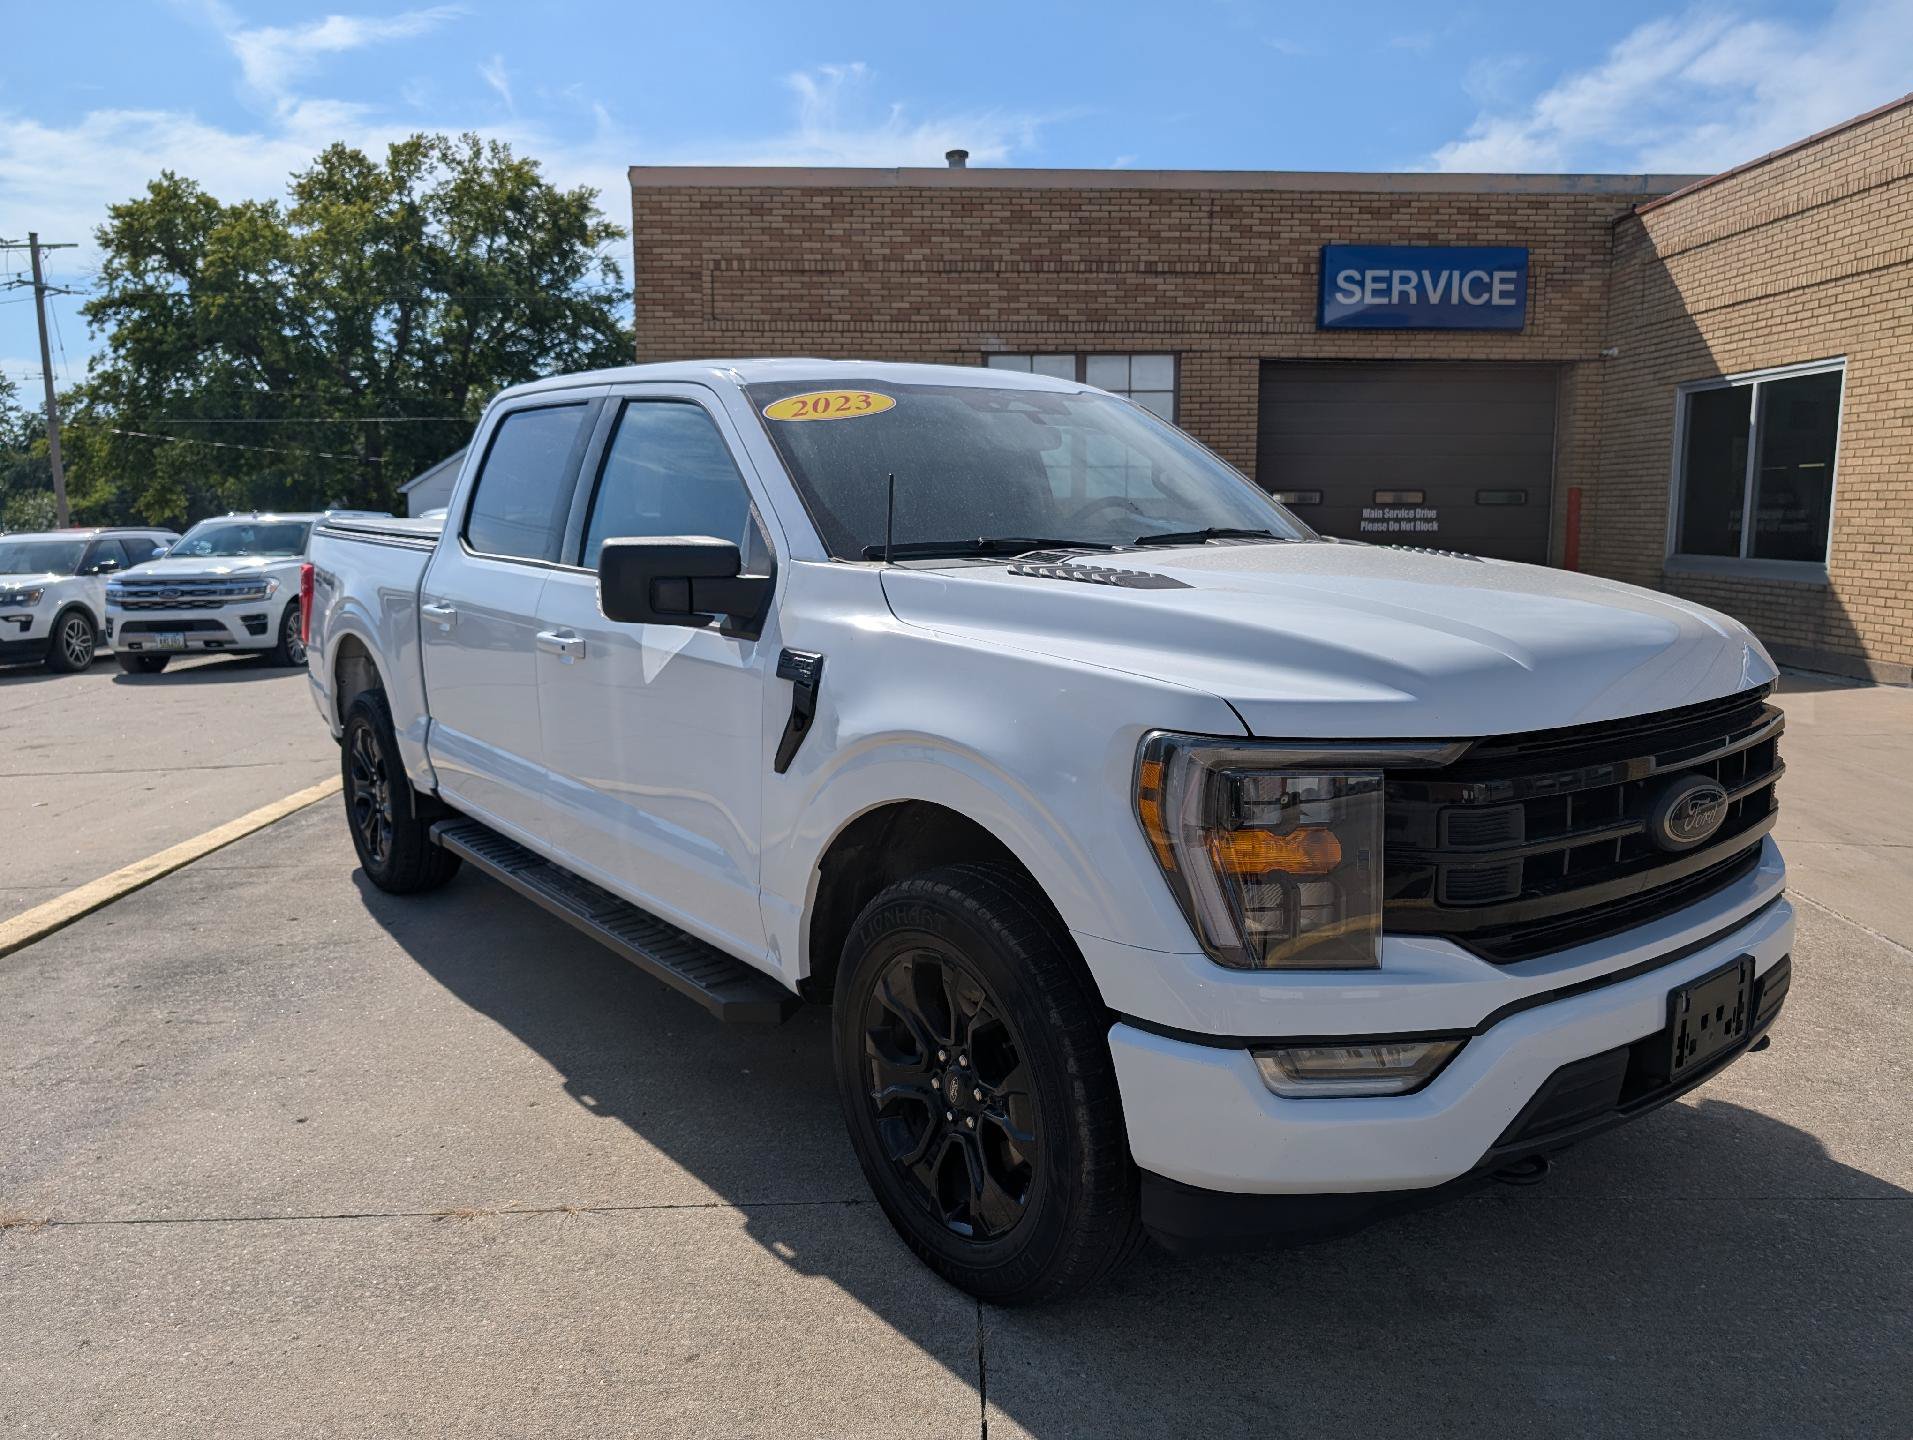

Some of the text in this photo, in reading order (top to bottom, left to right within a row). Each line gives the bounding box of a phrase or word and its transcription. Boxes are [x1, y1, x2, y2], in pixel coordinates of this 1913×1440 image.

[1335, 269, 1517, 306] SERVICE
[791, 394, 872, 418] 2023
[1362, 507, 1437, 518] Main Service Drive
[1360, 520, 1439, 531] Please Do Not Block
[1683, 797, 1719, 832] Ford
